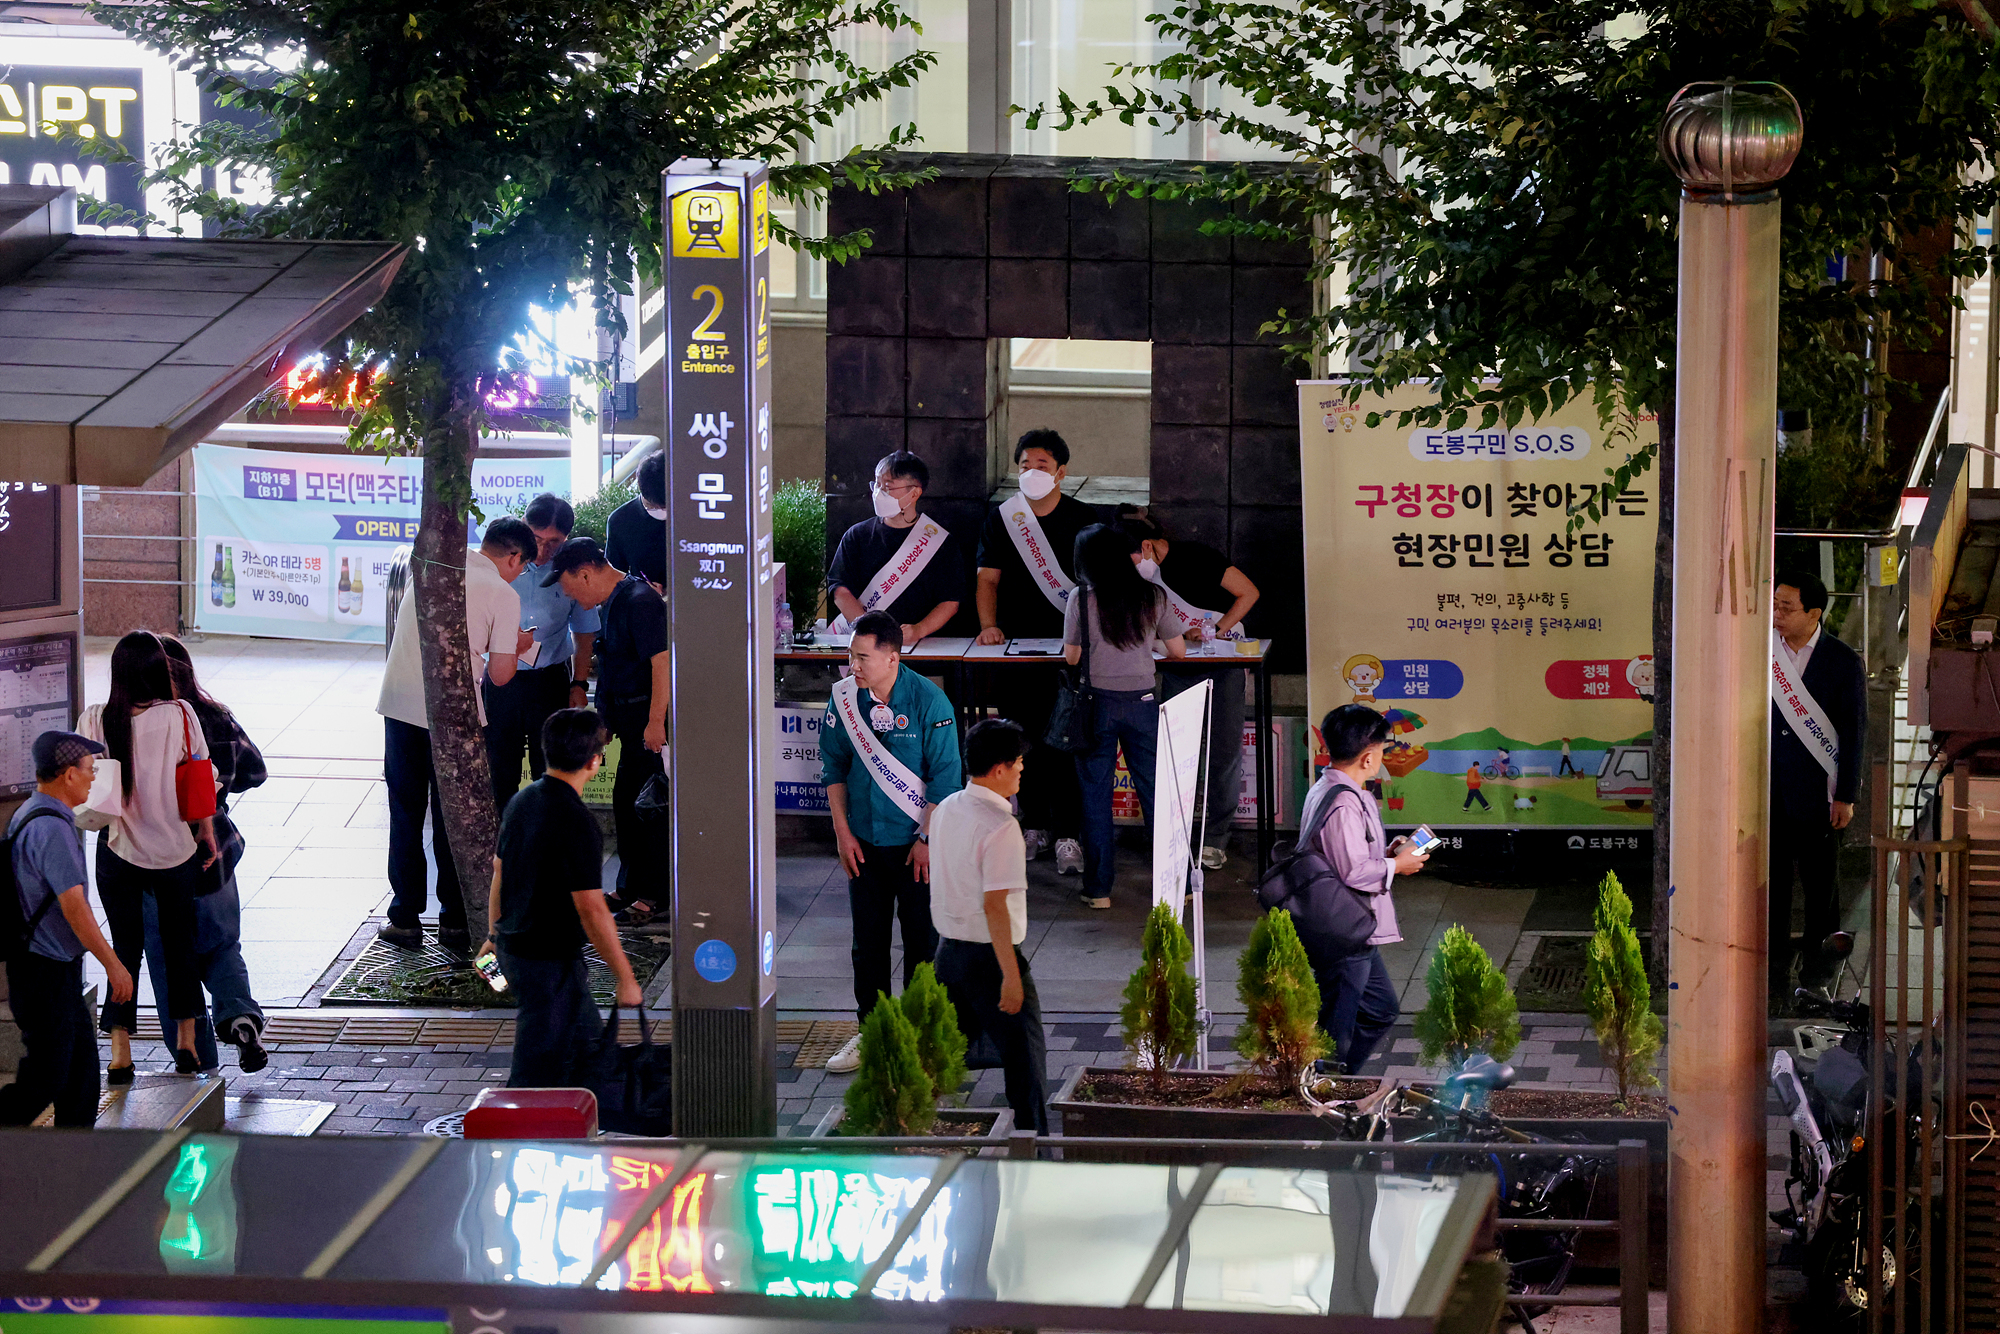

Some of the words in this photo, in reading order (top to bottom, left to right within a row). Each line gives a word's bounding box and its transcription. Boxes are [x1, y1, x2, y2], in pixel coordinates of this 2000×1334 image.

[691, 284, 726, 341] 2
[757, 276, 767, 336] 2
[686, 344, 730, 360] 출입구
[681, 361, 735, 374] Entrance
[1425, 434, 1506, 456] 도봉구민
[1513, 434, 1575, 454] S.O.S
[687, 411, 735, 519] 쌍문
[249, 470, 291, 487] 지하1층
[305, 471, 423, 506] 모던(맥주타
[480, 475, 544, 488] MODERN
[257, 485, 284, 499] (B1)
[472, 493, 513, 507] hisky
[1354, 481, 1493, 519] 구청장이
[1506, 481, 1649, 518] 찾아가는
[355, 520, 400, 538] OPEN
[679, 539, 745, 556] Ssangmun
[896, 536, 929, 575] 구청장과
[1391, 532, 1530, 568] 현장민원
[1543, 532, 1614, 568] 상담
[242, 550, 262, 566] 카스
[263, 555, 278, 568] OR
[281, 555, 303, 570] 테라
[304, 557, 321, 571] 5병
[699, 559, 725, 573] 双门
[692, 577, 733, 590] サンムン
[879, 572, 901, 595] 함께
[268, 589, 309, 607] 39,000
[1436, 592, 1465, 612] 불편,
[1470, 592, 1501, 610] 건의,
[1506, 591, 1555, 610] 고충사항
[1560, 592, 1569, 610] 등
[1406, 617, 1430, 632] 구민
[1434, 617, 1485, 635] 여러분의
[1490, 617, 1533, 636] 목소리를
[1539, 617, 1602, 636] 들려주세요!
[1402, 663, 1429, 678] 민원
[1582, 664, 1610, 678] 정책
[1402, 681, 1430, 695] 상담
[1582, 681, 1610, 696] 제안
[1788, 694, 1808, 717] 함께
[870, 753, 910, 793] 현장민원
[906, 789, 928, 809] 상담
[1588, 836, 1639, 850] 도봉구청
